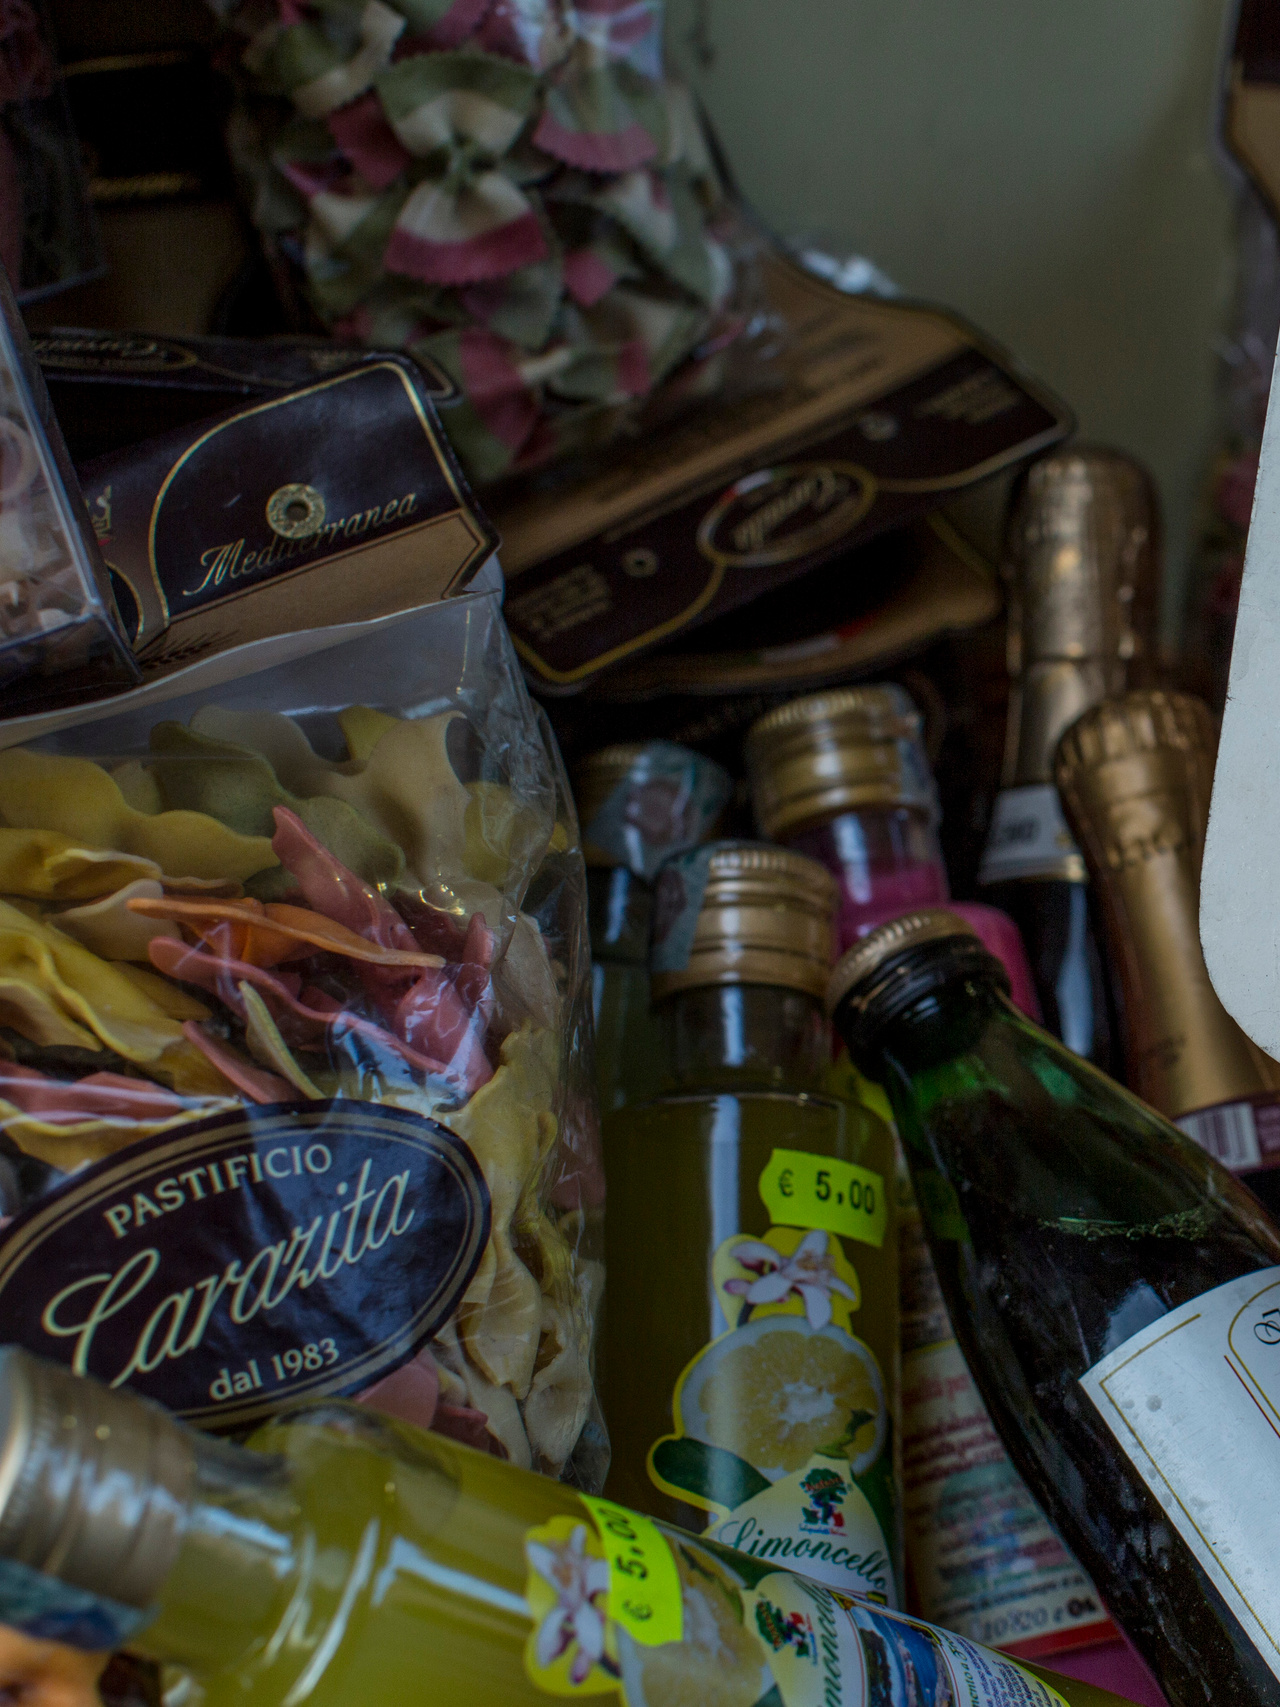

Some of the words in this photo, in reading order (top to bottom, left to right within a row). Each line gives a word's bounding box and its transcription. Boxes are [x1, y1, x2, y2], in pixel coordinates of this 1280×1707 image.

[103, 1143, 332, 1239] PASTIFICIO
[778, 1168, 794, 1198] €
[42, 1158, 416, 1389] Carazita
[209, 1357, 262, 1402] dal
[272, 1337, 341, 1381] 1983
[718, 1517, 889, 1590] Limoncello
